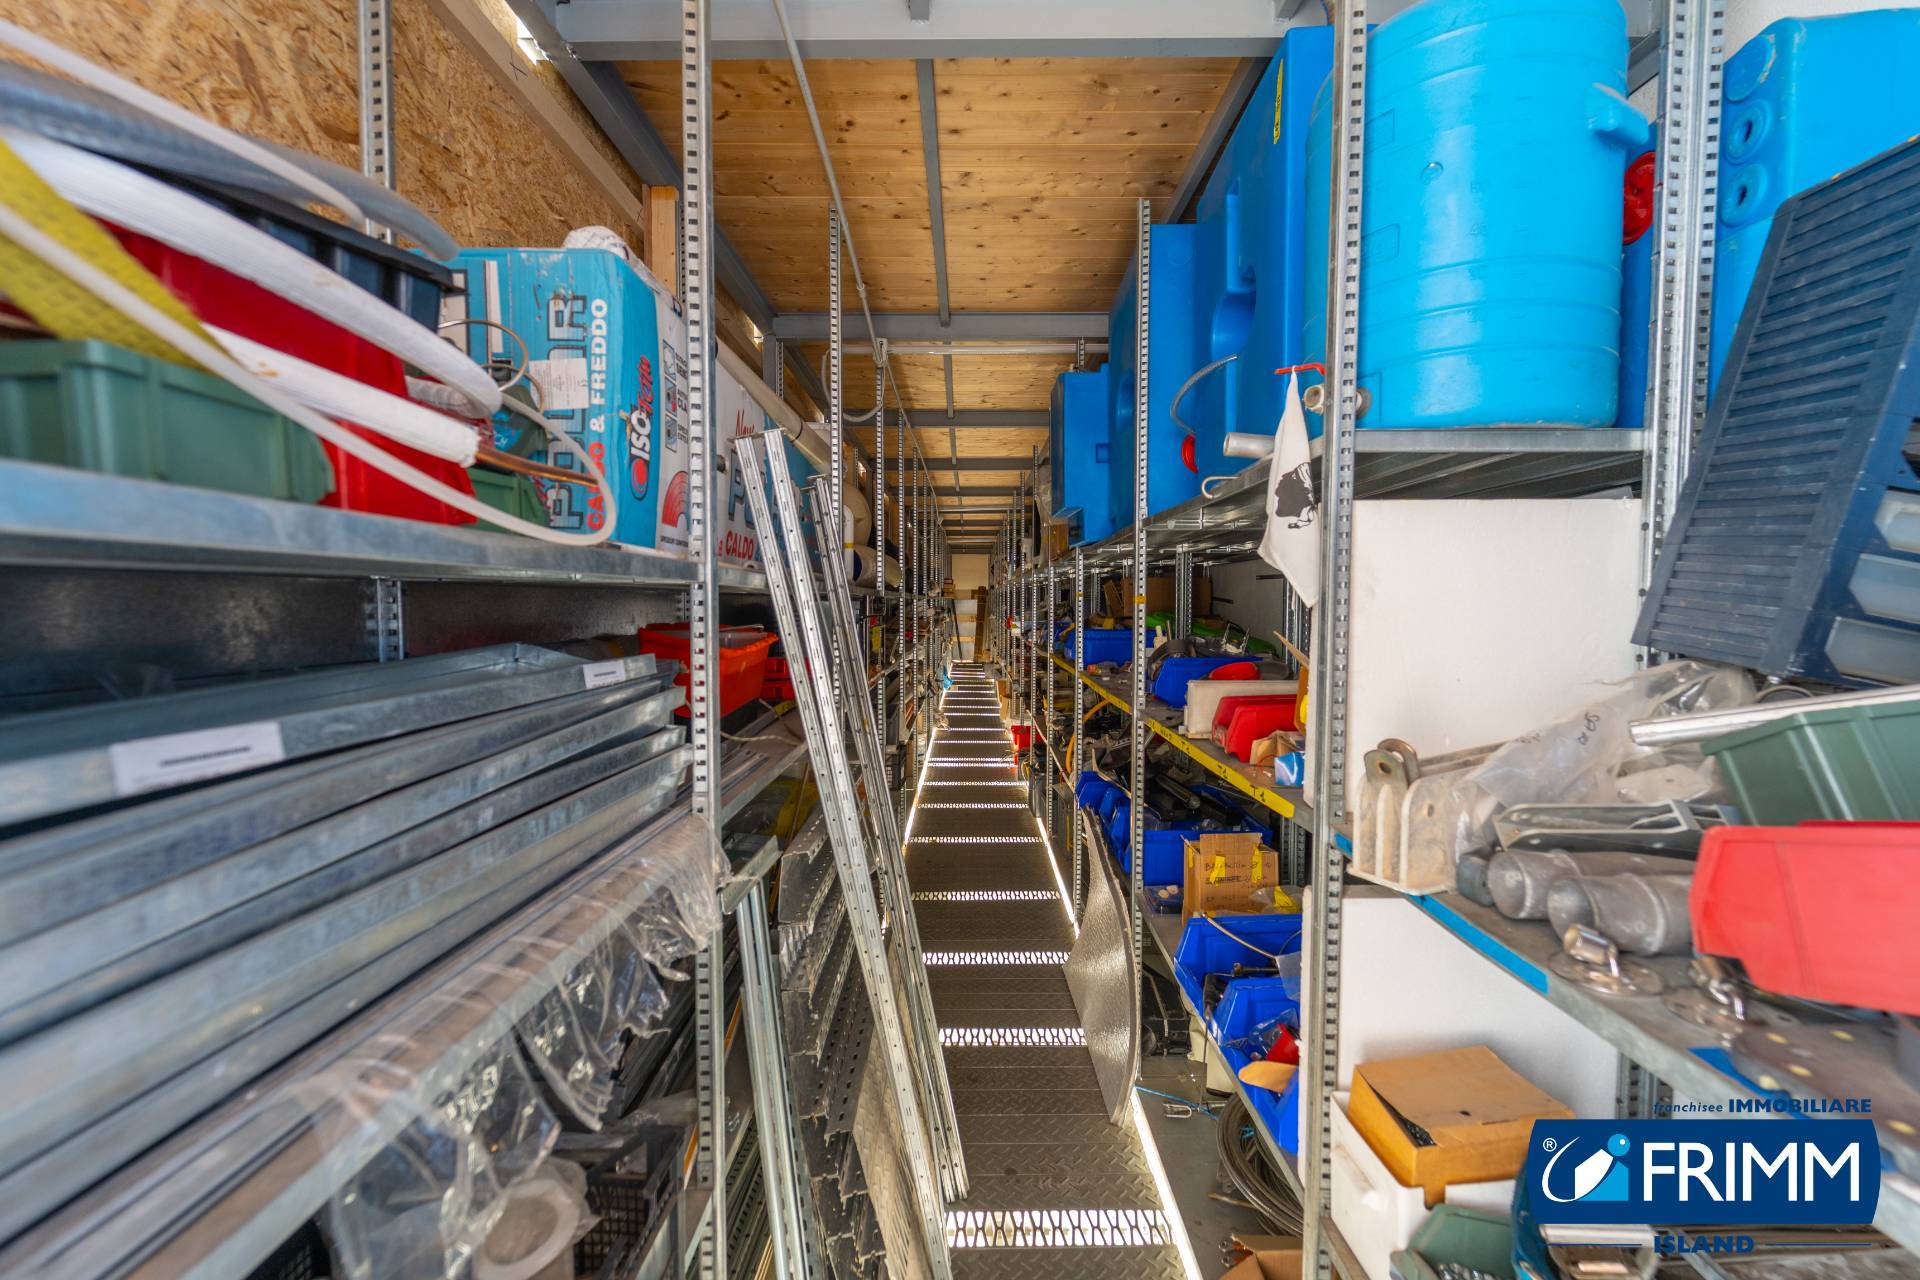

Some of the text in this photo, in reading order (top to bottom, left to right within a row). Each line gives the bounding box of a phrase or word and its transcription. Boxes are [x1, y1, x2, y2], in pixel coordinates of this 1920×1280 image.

[591, 298, 608, 405] FREDDO
[547, 295, 587, 529] POLR
[590, 414, 605, 432] &
[725, 530, 755, 561] CALDO
